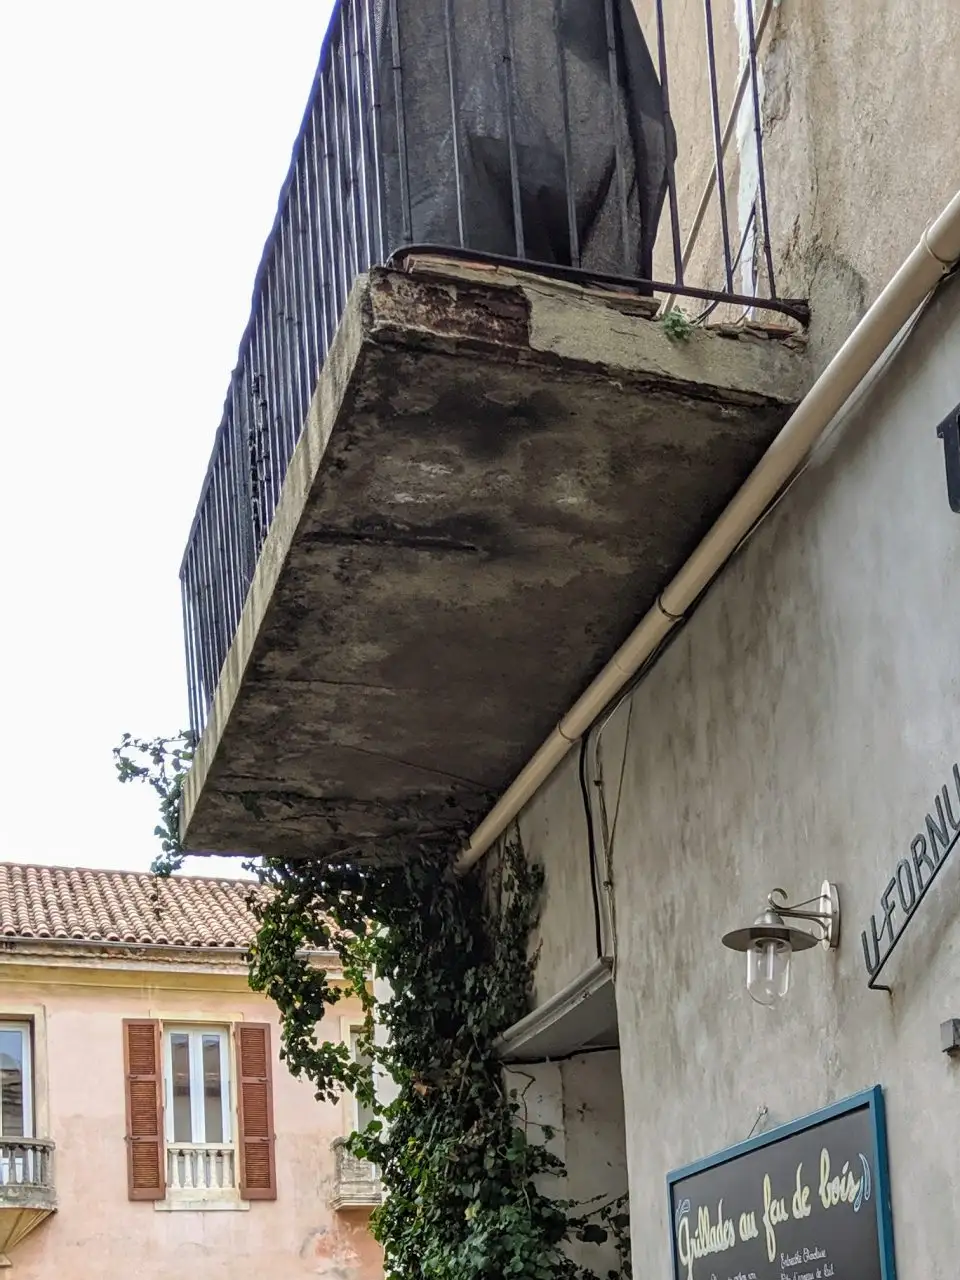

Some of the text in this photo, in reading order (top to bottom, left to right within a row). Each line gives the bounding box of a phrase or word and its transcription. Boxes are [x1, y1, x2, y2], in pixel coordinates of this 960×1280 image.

[739, 1211, 759, 1241] au
[763, 1172, 789, 1263] feu
[792, 1162, 812, 1219] de
